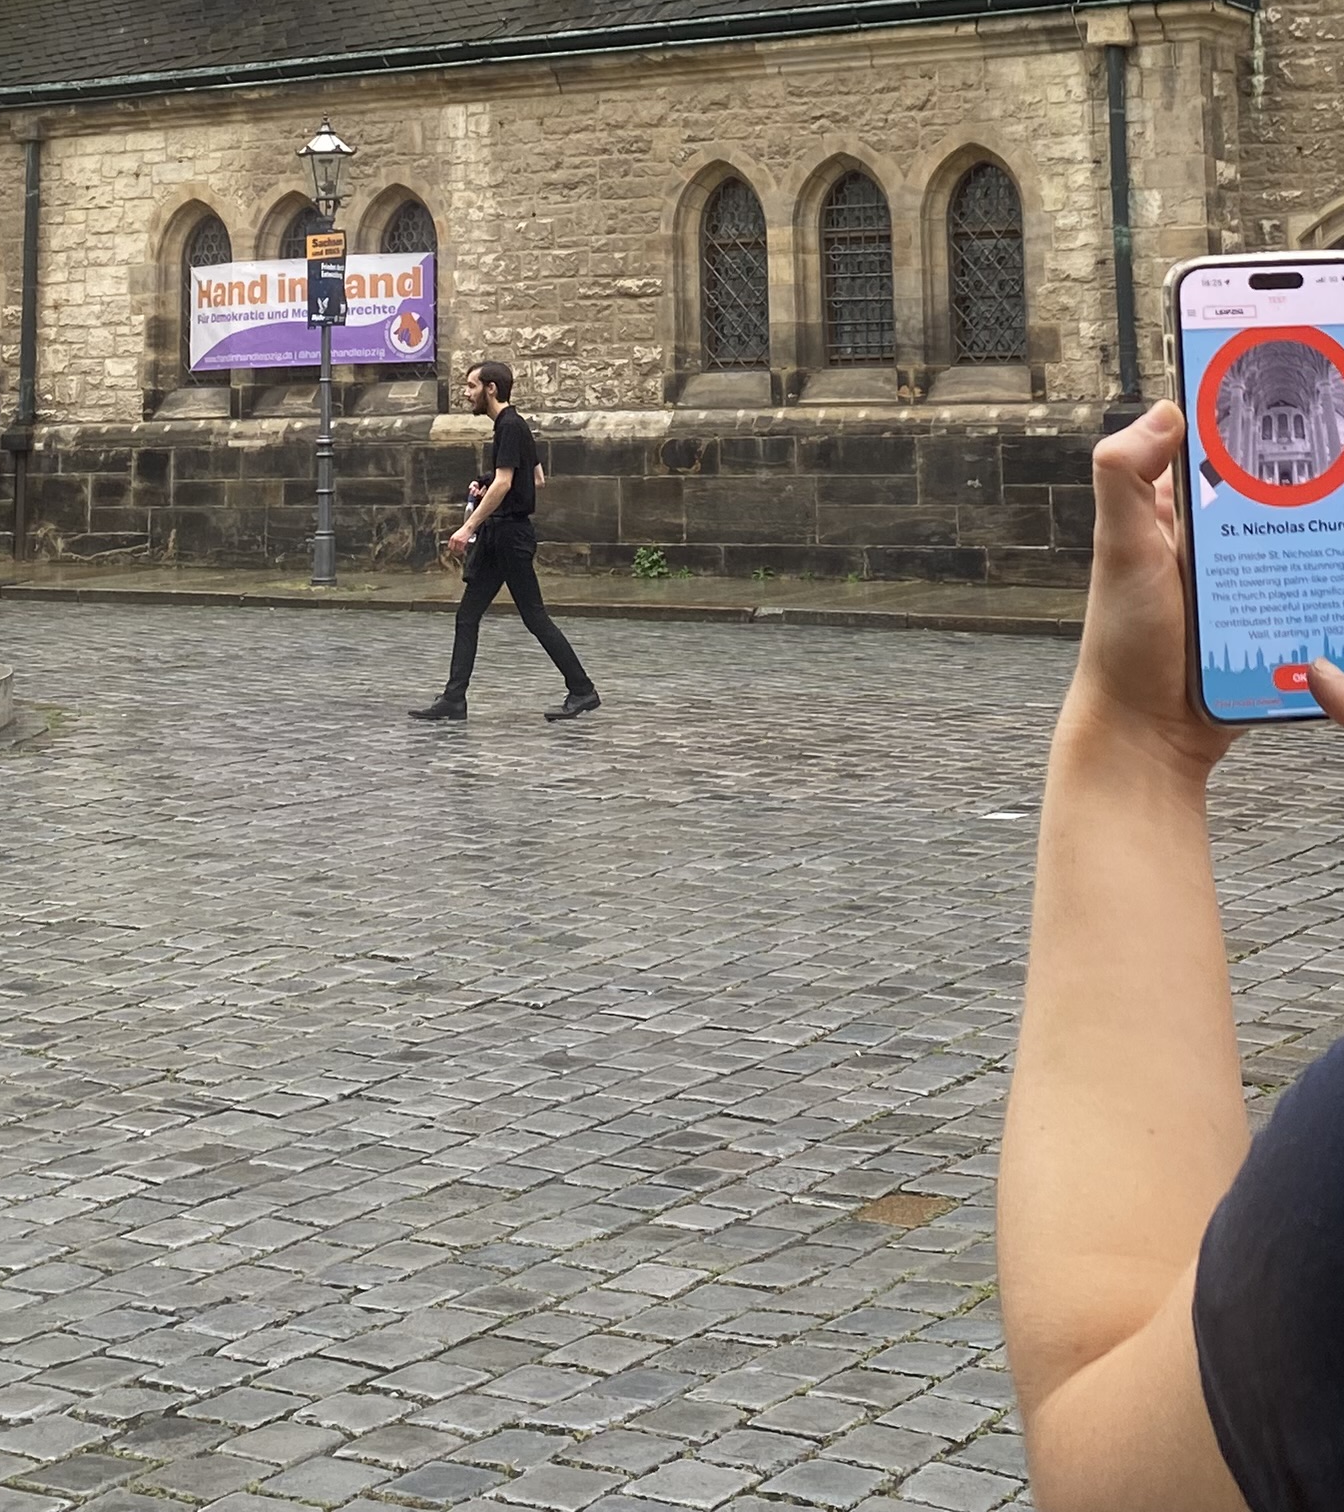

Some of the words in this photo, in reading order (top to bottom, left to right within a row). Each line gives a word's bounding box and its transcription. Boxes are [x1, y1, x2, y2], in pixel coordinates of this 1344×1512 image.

[197, 274, 268, 309] Hand
[277, 273, 308, 303] in
[346, 266, 422, 299] and
[210, 310, 265, 324] Demokratie
[267, 308, 289, 320] und
[1221, 523, 1239, 537] St.
[1243, 520, 1305, 535] Nicholas
[1214, 553, 1236, 563] Step
[1238, 552, 1266, 561] inside
[1282, 549, 1323, 559] Nicholas
[1206, 566, 1239, 577] Leipzig
[1242, 566, 1251, 575] to
[1254, 564, 1287, 573] admire
[1304, 561, 1344, 572] stunning
[1215, 579, 1237, 588] with
[1239, 578, 1281, 588] towering
[1212, 592, 1230, 601] This
[1232, 591, 1266, 601] church
[1268, 589, 1299, 600] played
[1230, 605, 1239, 615] in
[1241, 604, 1257, 613] the
[1260, 602, 1300, 614] peaceful
[1302, 600, 1340, 611] protests
[1215, 618, 1271, 629] contributed
[1274, 617, 1283, 626] to
[1286, 615, 1302, 624] the
[1304, 614, 1318, 623] fall
[1320, 613, 1330, 622] of
[1273, 628, 1309, 638] starting
[1312, 627, 1321, 636] in
